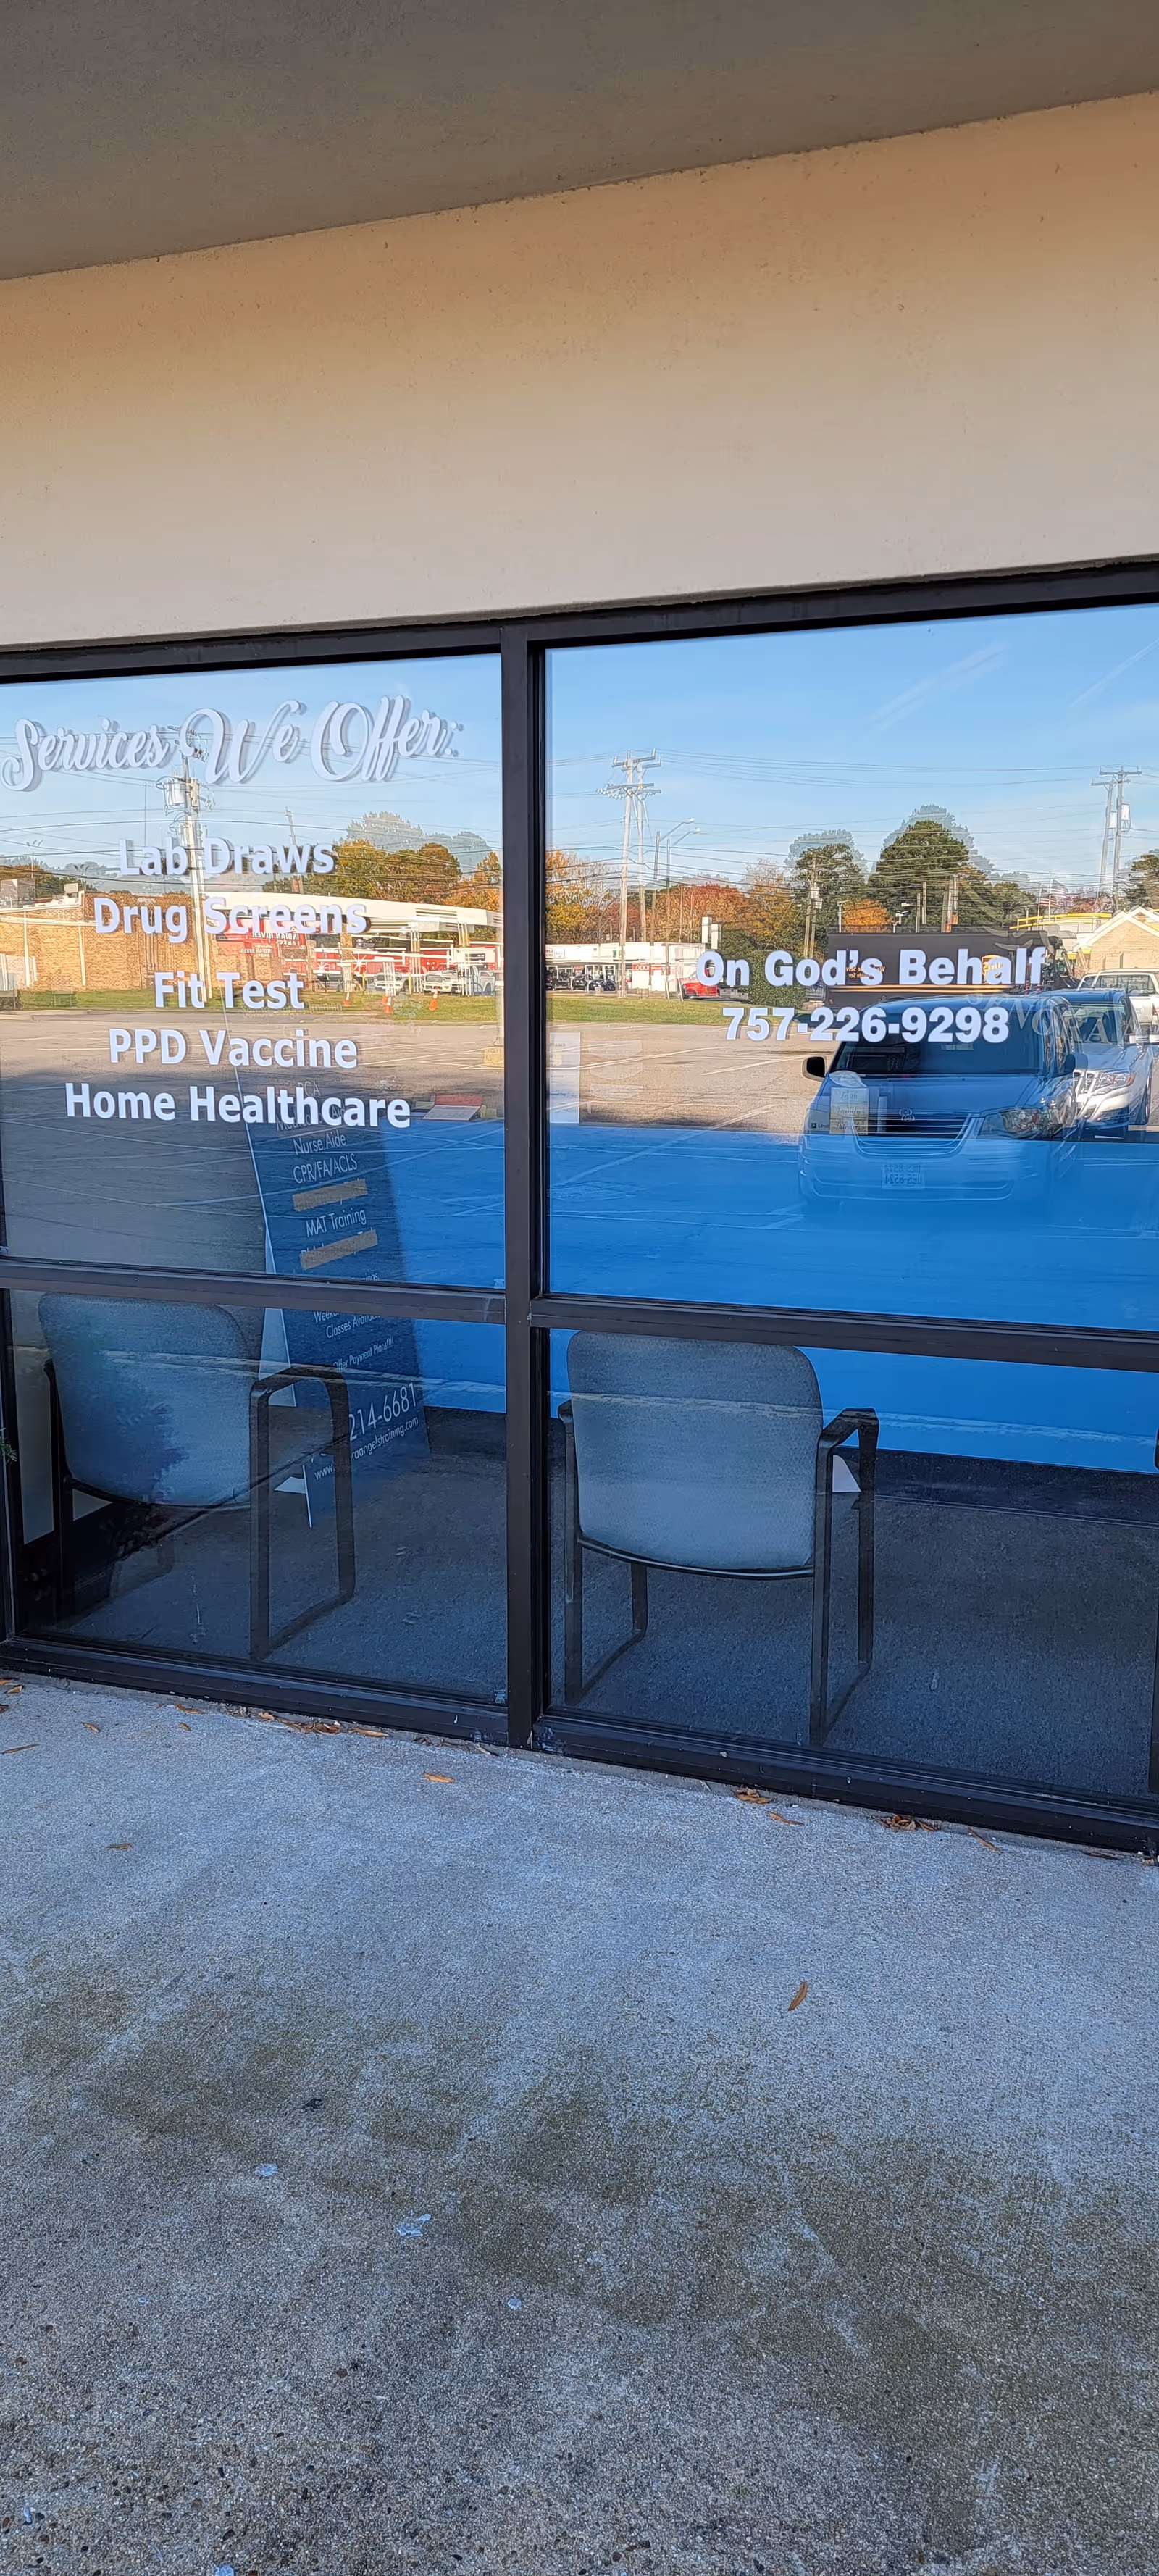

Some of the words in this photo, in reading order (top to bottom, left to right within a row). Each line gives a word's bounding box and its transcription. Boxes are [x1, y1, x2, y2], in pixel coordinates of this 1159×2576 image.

[2, 717, 171, 790] Services
[179, 699, 306, 784] We
[311, 695, 461, 782] Offer:
[120, 839, 188, 875] Lab
[204, 838, 335, 874] Draws
[94, 898, 188, 942] Drug
[204, 897, 368, 934] Screens
[697, 952, 750, 986] On
[765, 950, 883, 986] God’s
[900, 948, 1045, 985] Behalf
[154, 971, 205, 1008] Fit
[217, 971, 304, 1009] Test
[723, 1008, 1009, 1044] 757-226-9298
[109, 1028, 186, 1064] PPD
[200, 1029, 359, 1068] Vaccine
[65, 1083, 175, 1120] Home
[191, 1087, 411, 1128] Healthcare
[293, 1137, 324, 1155] Nurse
[325, 1129, 346, 1150] Aide
[293, 1153, 358, 1184] CPR/FA/ACLS
[306, 1215, 327, 1237] MAT
[328, 1208, 367, 1230] Training
[326, 1321, 351, 1339] Classes
[349, 1348, 372, 1366] Payment
